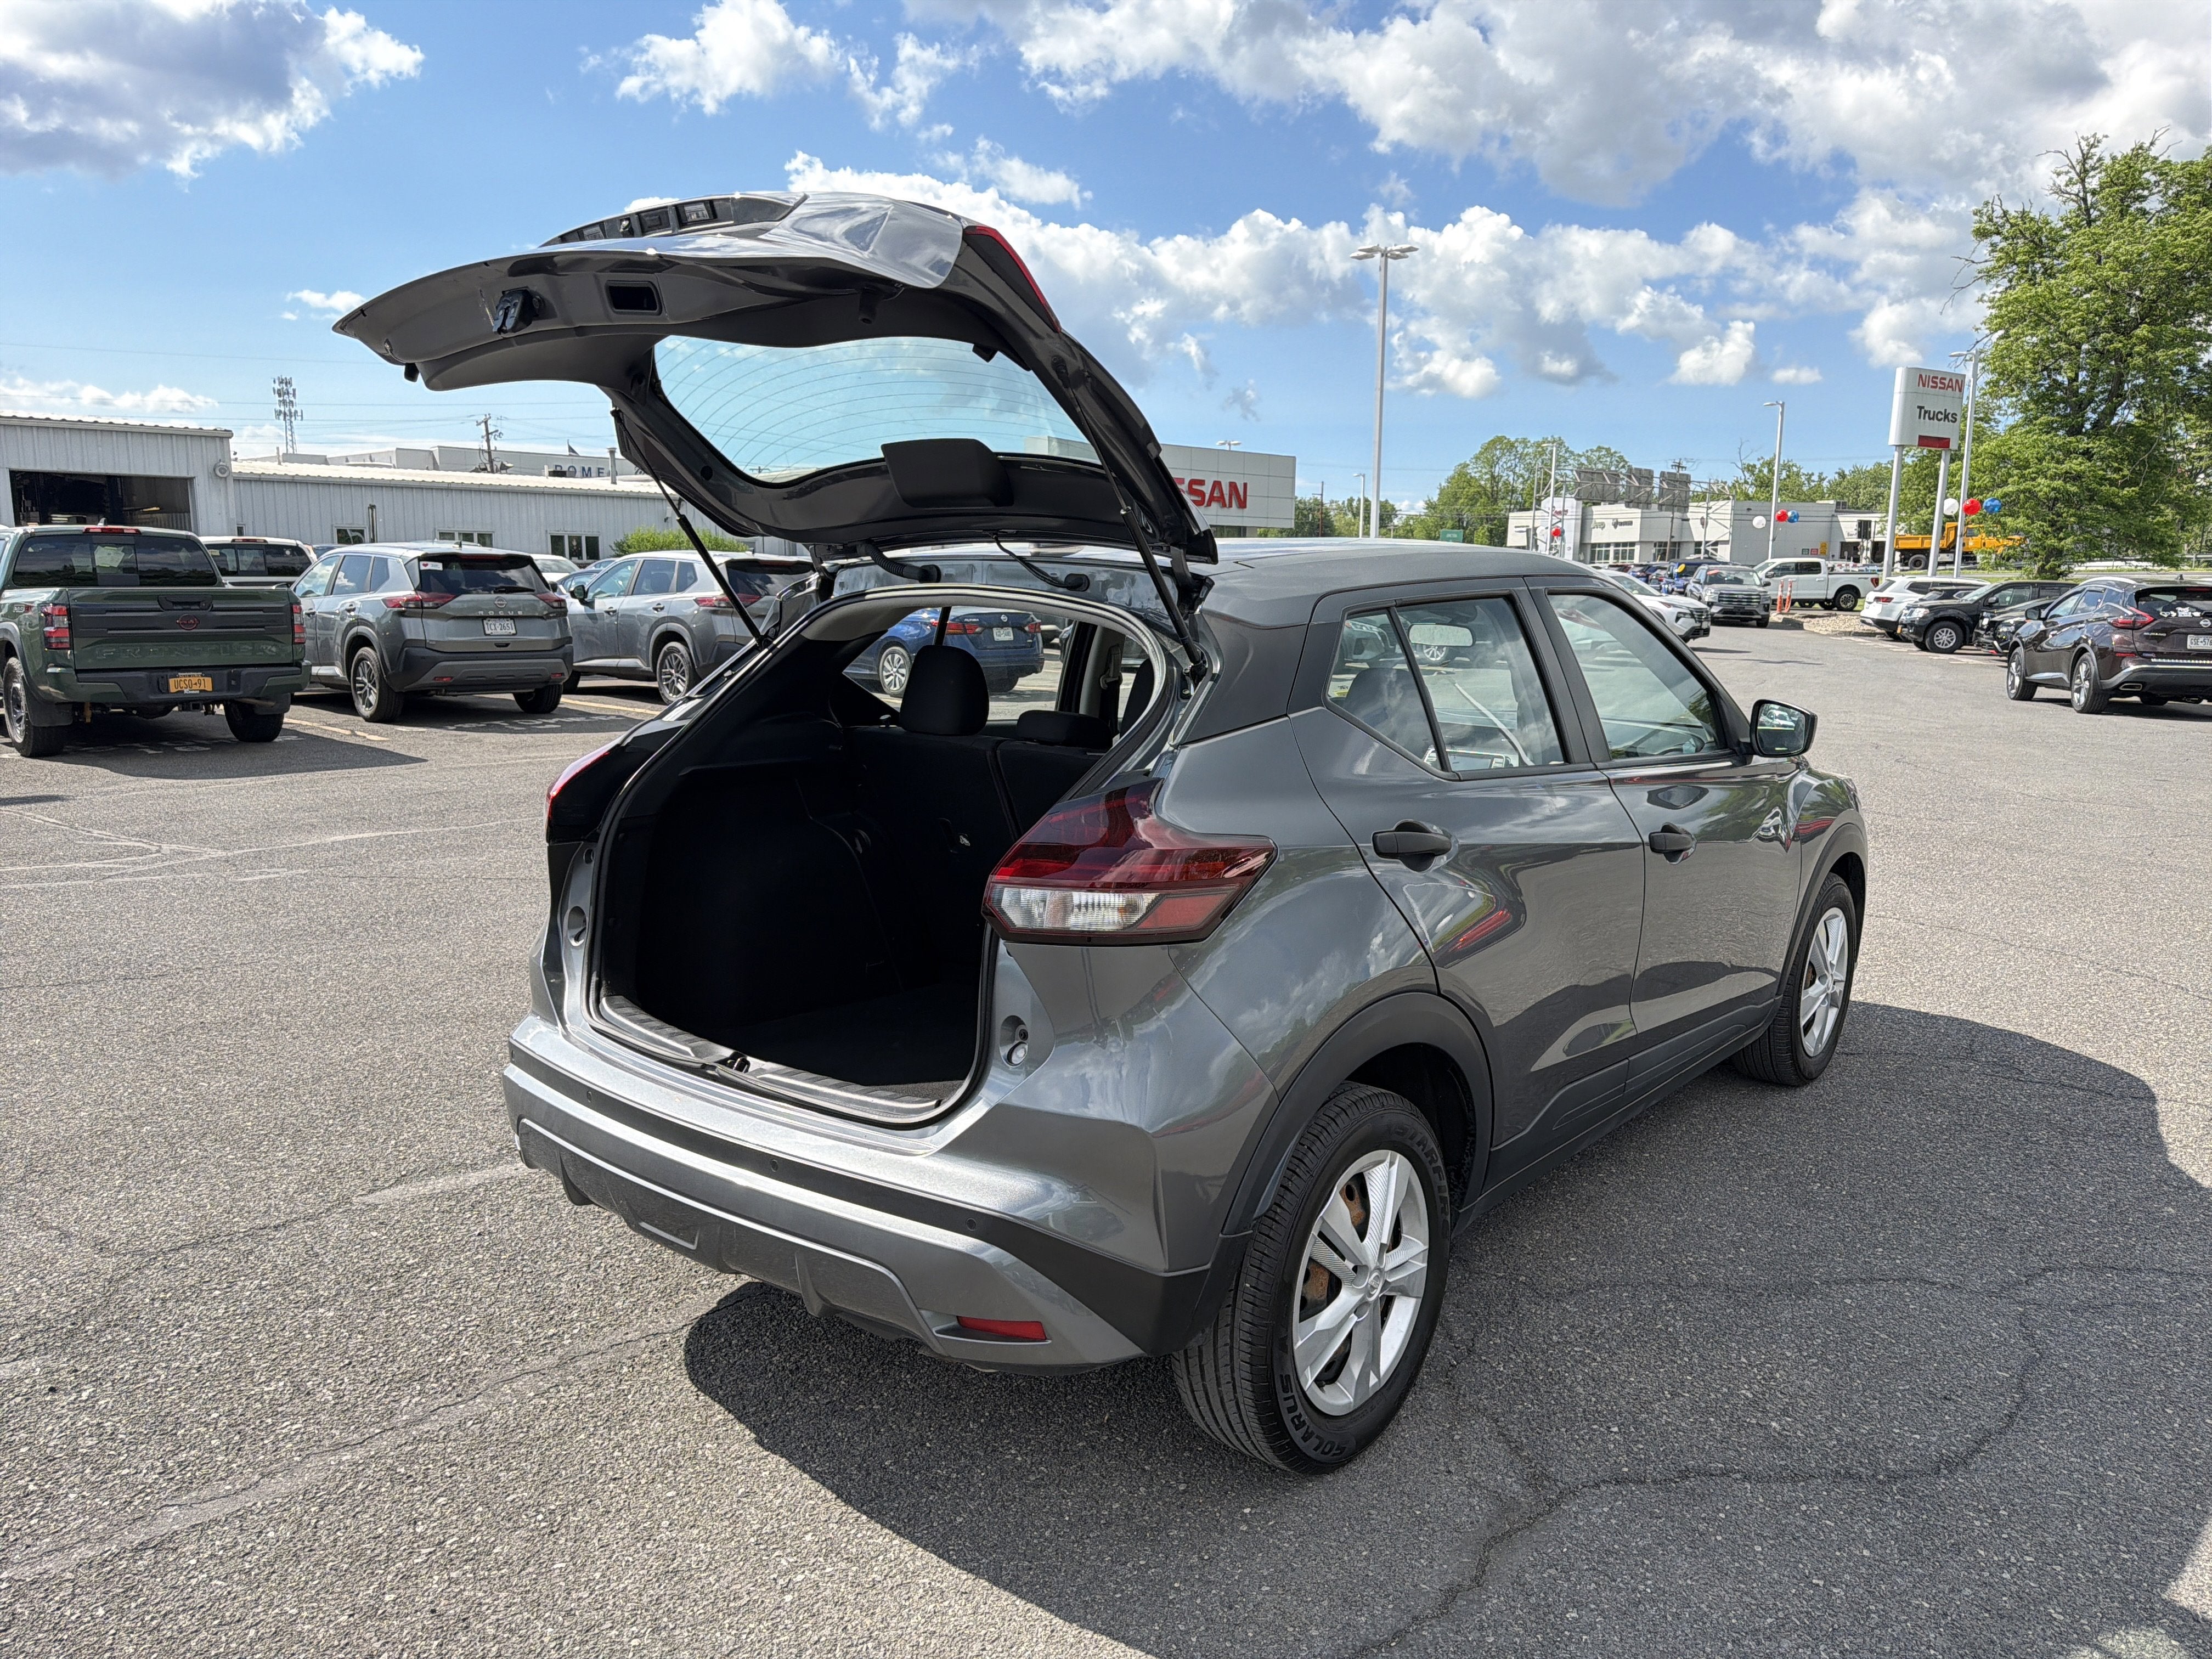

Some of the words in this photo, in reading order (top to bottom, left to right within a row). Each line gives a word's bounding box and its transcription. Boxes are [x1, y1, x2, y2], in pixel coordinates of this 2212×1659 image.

[1917, 374, 1963, 392] NISSAN
[1917, 405, 1957, 423] Trucks
[1280, 1374, 1347, 1457] SOLARUS
